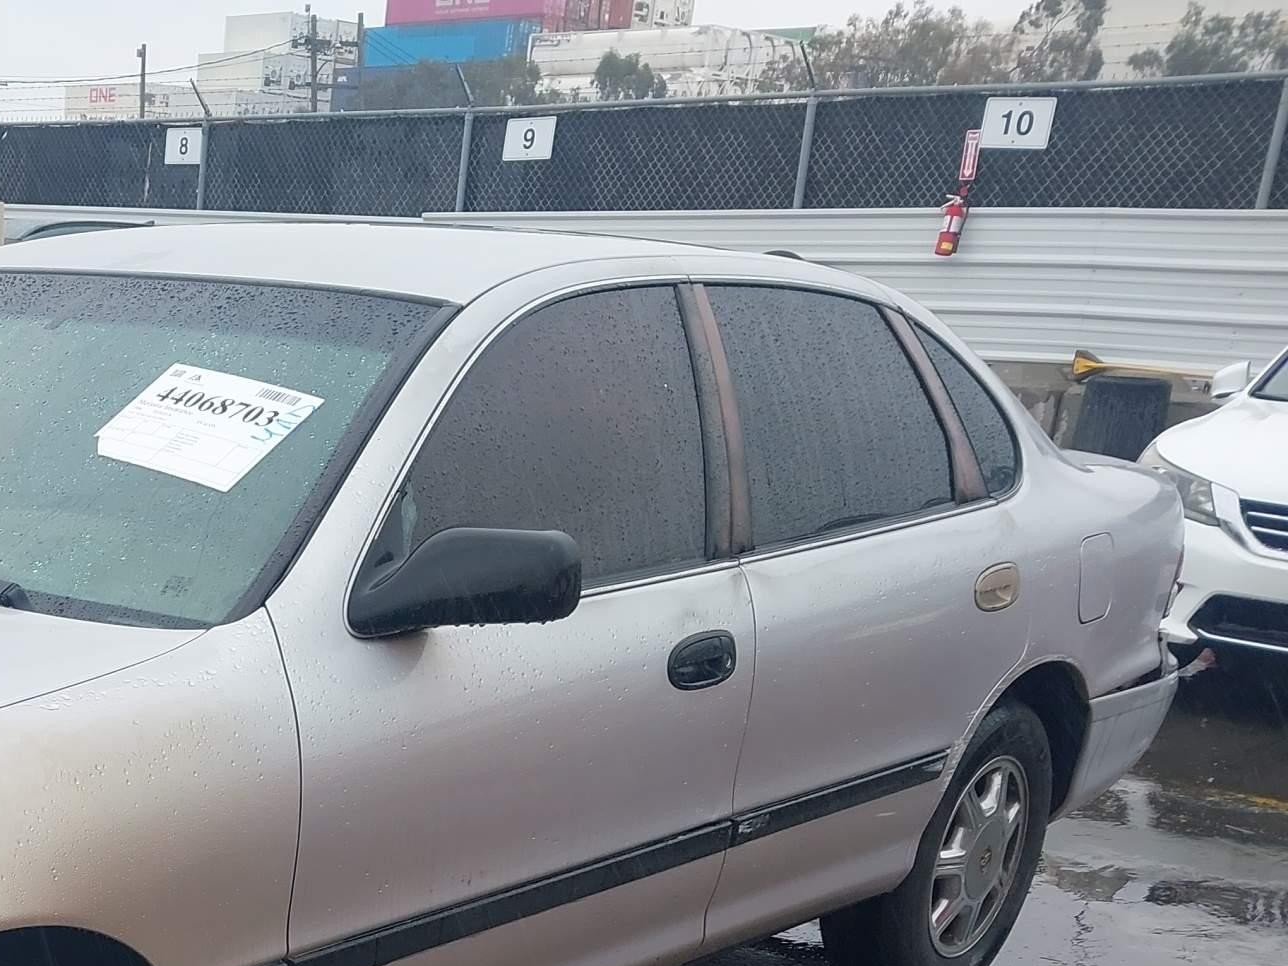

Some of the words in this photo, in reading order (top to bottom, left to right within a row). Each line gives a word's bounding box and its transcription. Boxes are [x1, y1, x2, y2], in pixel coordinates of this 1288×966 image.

[89, 88, 116, 103] ONE
[1001, 110, 1035, 136] 10
[179, 137, 189, 155] 8
[523, 129, 535, 149] 9
[155, 386, 280, 427] 44068703
